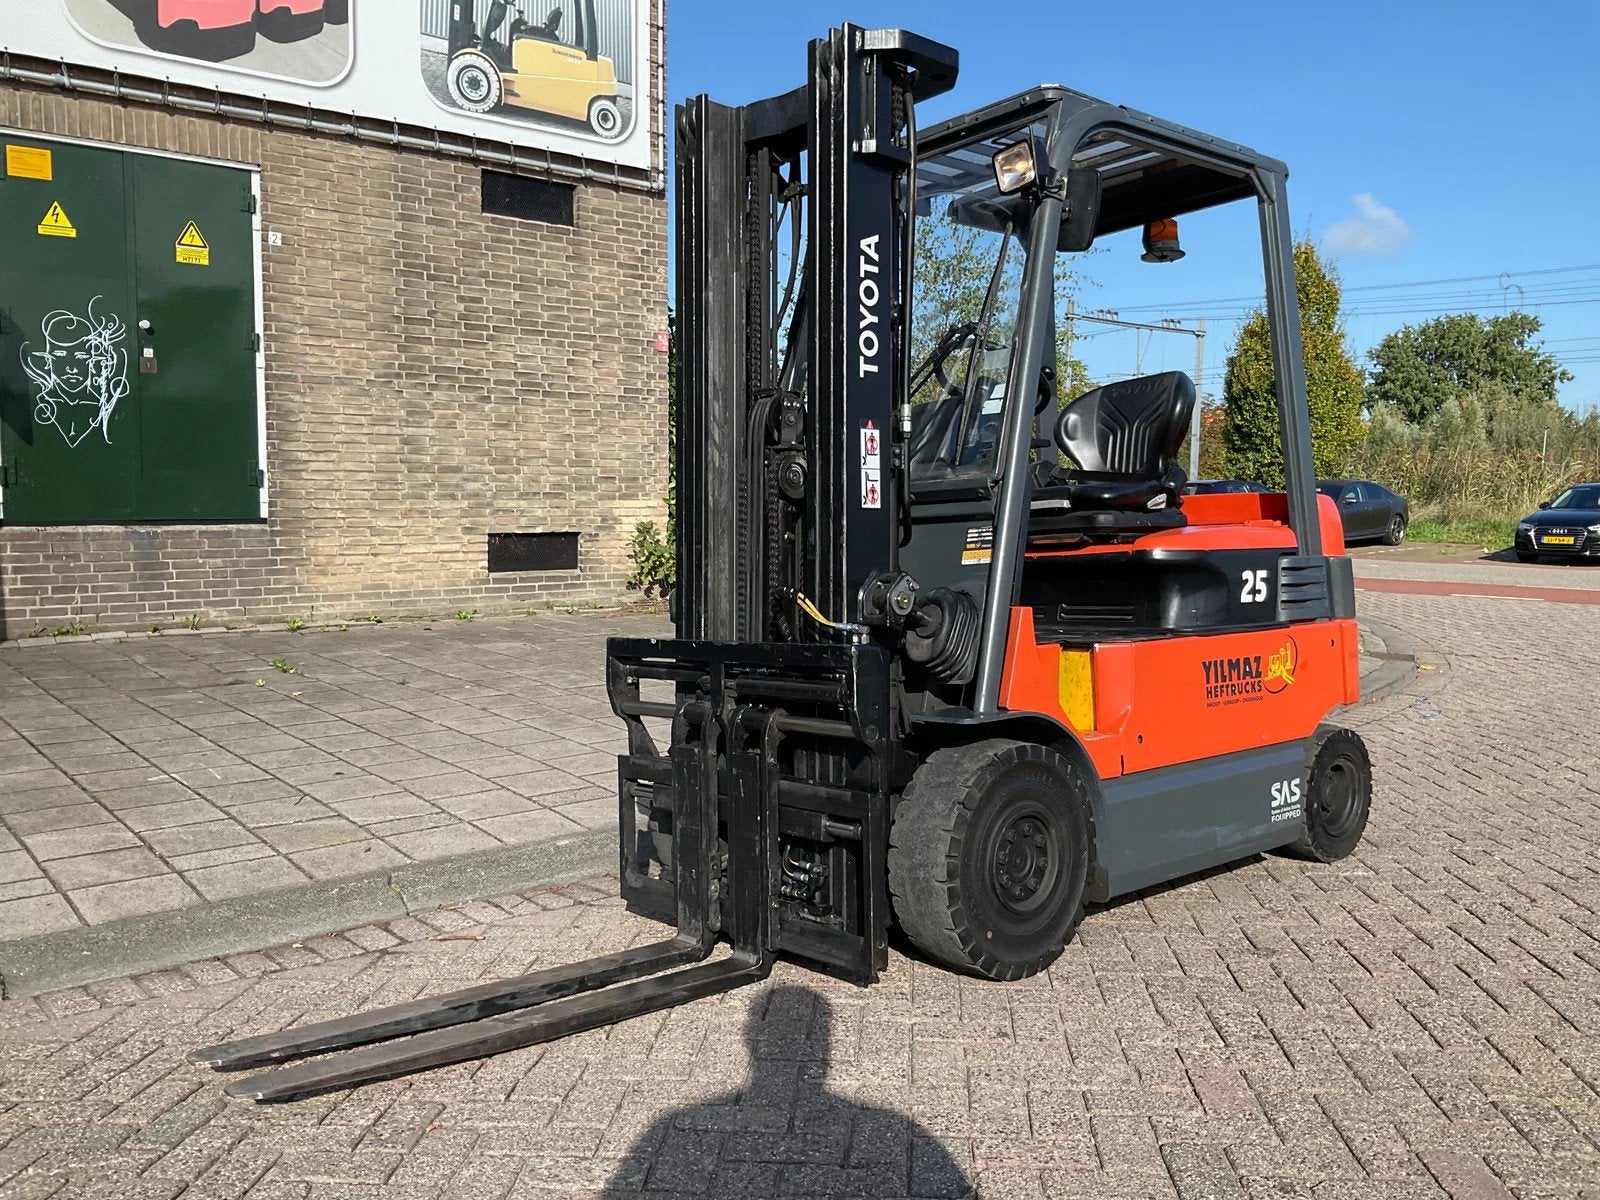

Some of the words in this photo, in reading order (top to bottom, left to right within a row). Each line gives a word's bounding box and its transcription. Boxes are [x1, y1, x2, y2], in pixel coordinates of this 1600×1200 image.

[271, 233, 279, 245] 2
[859, 234, 880, 378] TOYOTA
[1240, 569, 1268, 603] 25
[1201, 655, 1262, 685] YILMAZ
[1206, 680, 1263, 699] HEFTRUCKS
[1270, 777, 1301, 808] SAS
[1271, 809, 1301, 823] EQUIPPED
